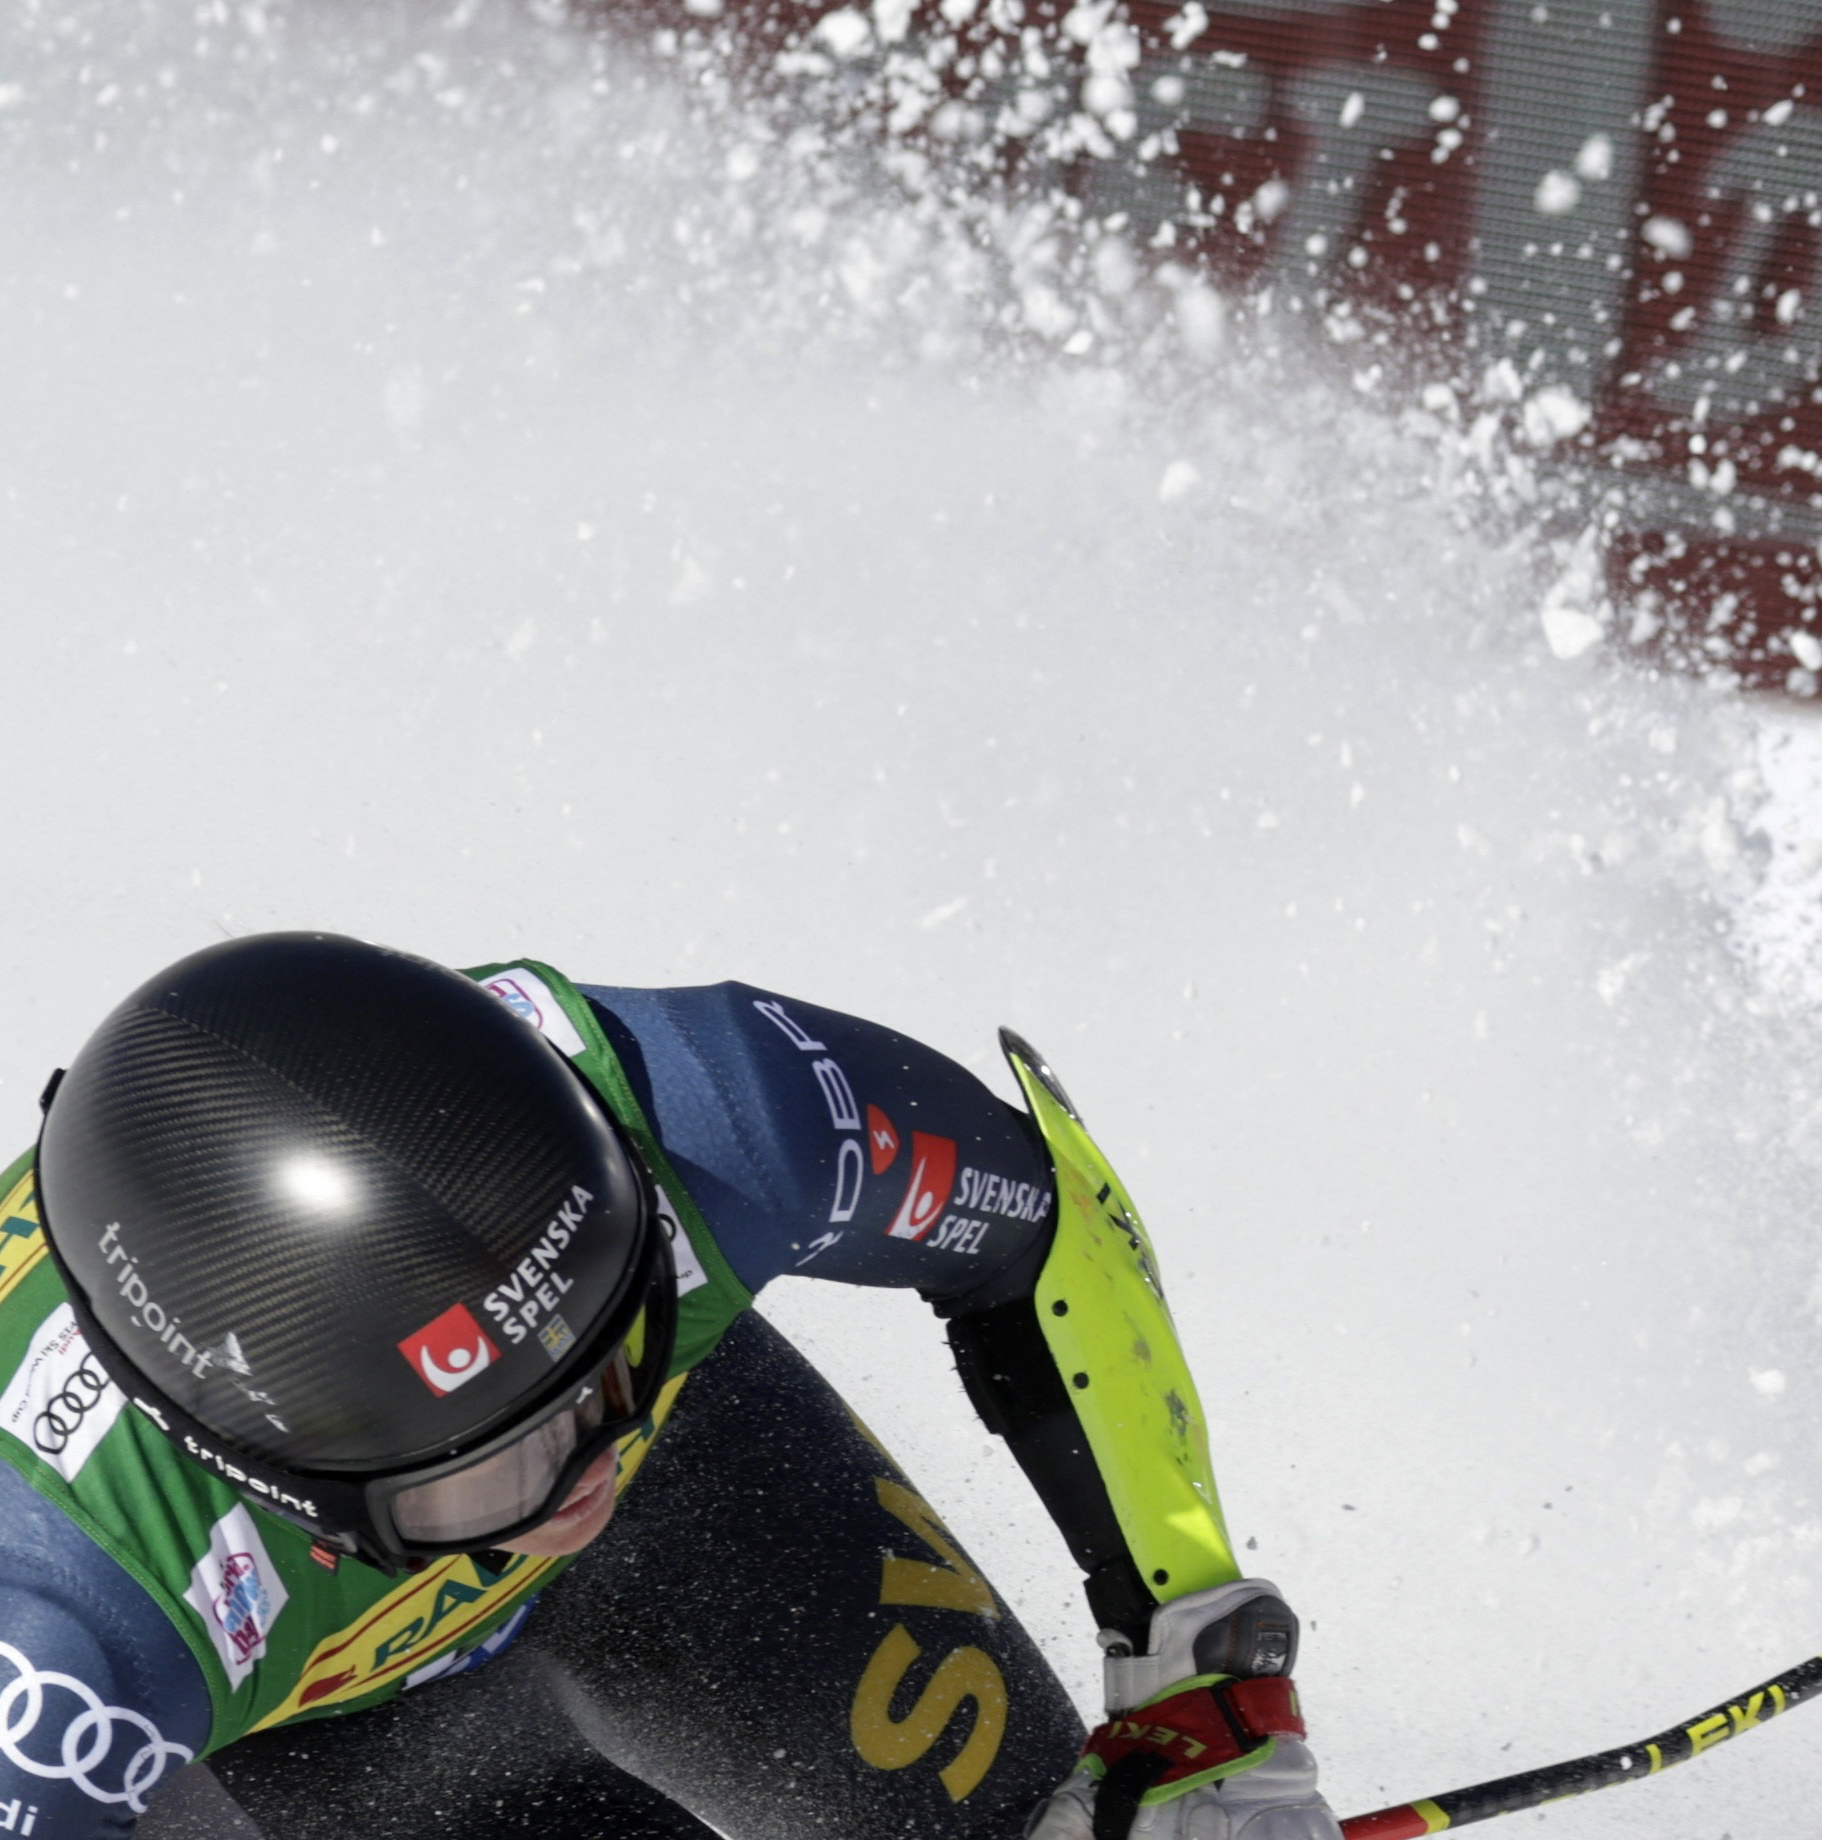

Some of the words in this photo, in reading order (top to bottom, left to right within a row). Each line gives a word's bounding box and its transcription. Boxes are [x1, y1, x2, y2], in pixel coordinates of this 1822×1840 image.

[954, 1166, 1053, 1224] SVENSKA
[482, 1184, 594, 1322] SVENSKA
[926, 1215, 991, 1255] SPEL
[98, 1221, 214, 1379] tripoint
[501, 1271, 574, 1345] SPEL
[183, 1435, 319, 1518] tripoint
[1107, 1720, 1209, 1760] LEKI
